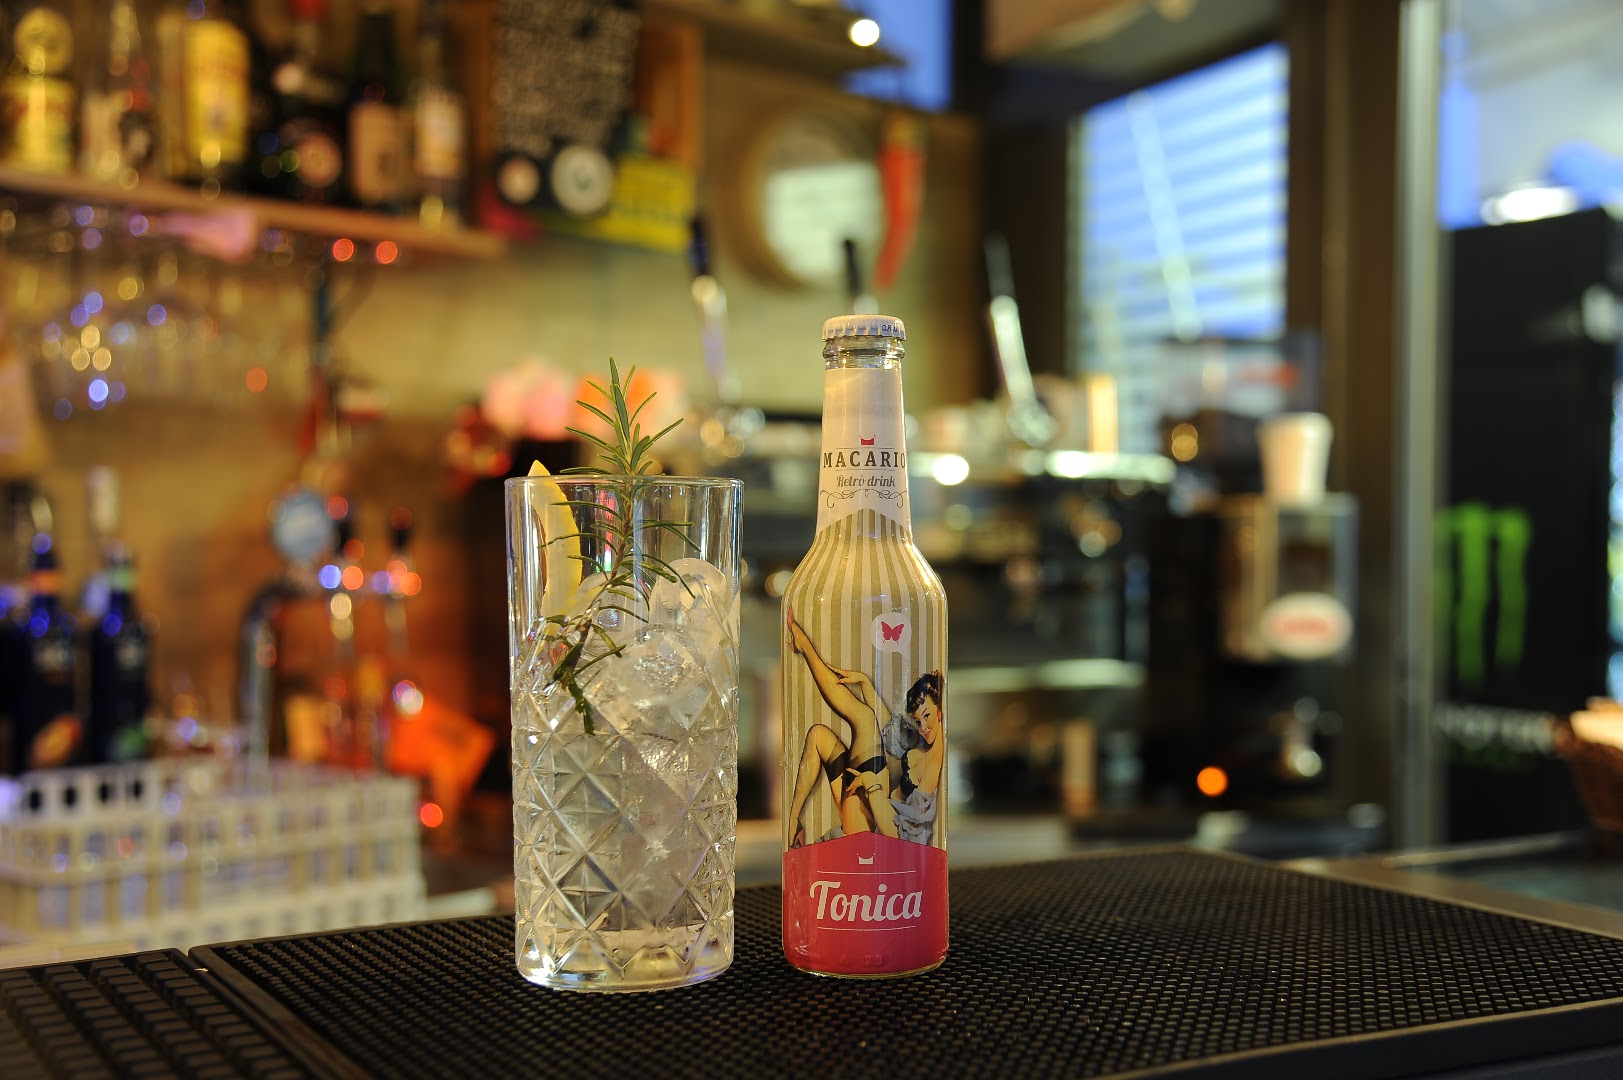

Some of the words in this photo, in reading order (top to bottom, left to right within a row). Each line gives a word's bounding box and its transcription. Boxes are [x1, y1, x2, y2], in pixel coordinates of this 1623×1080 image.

[823, 451, 905, 468] MACARIO
[867, 475, 895, 487] drink
[810, 880, 922, 921] Tonica
